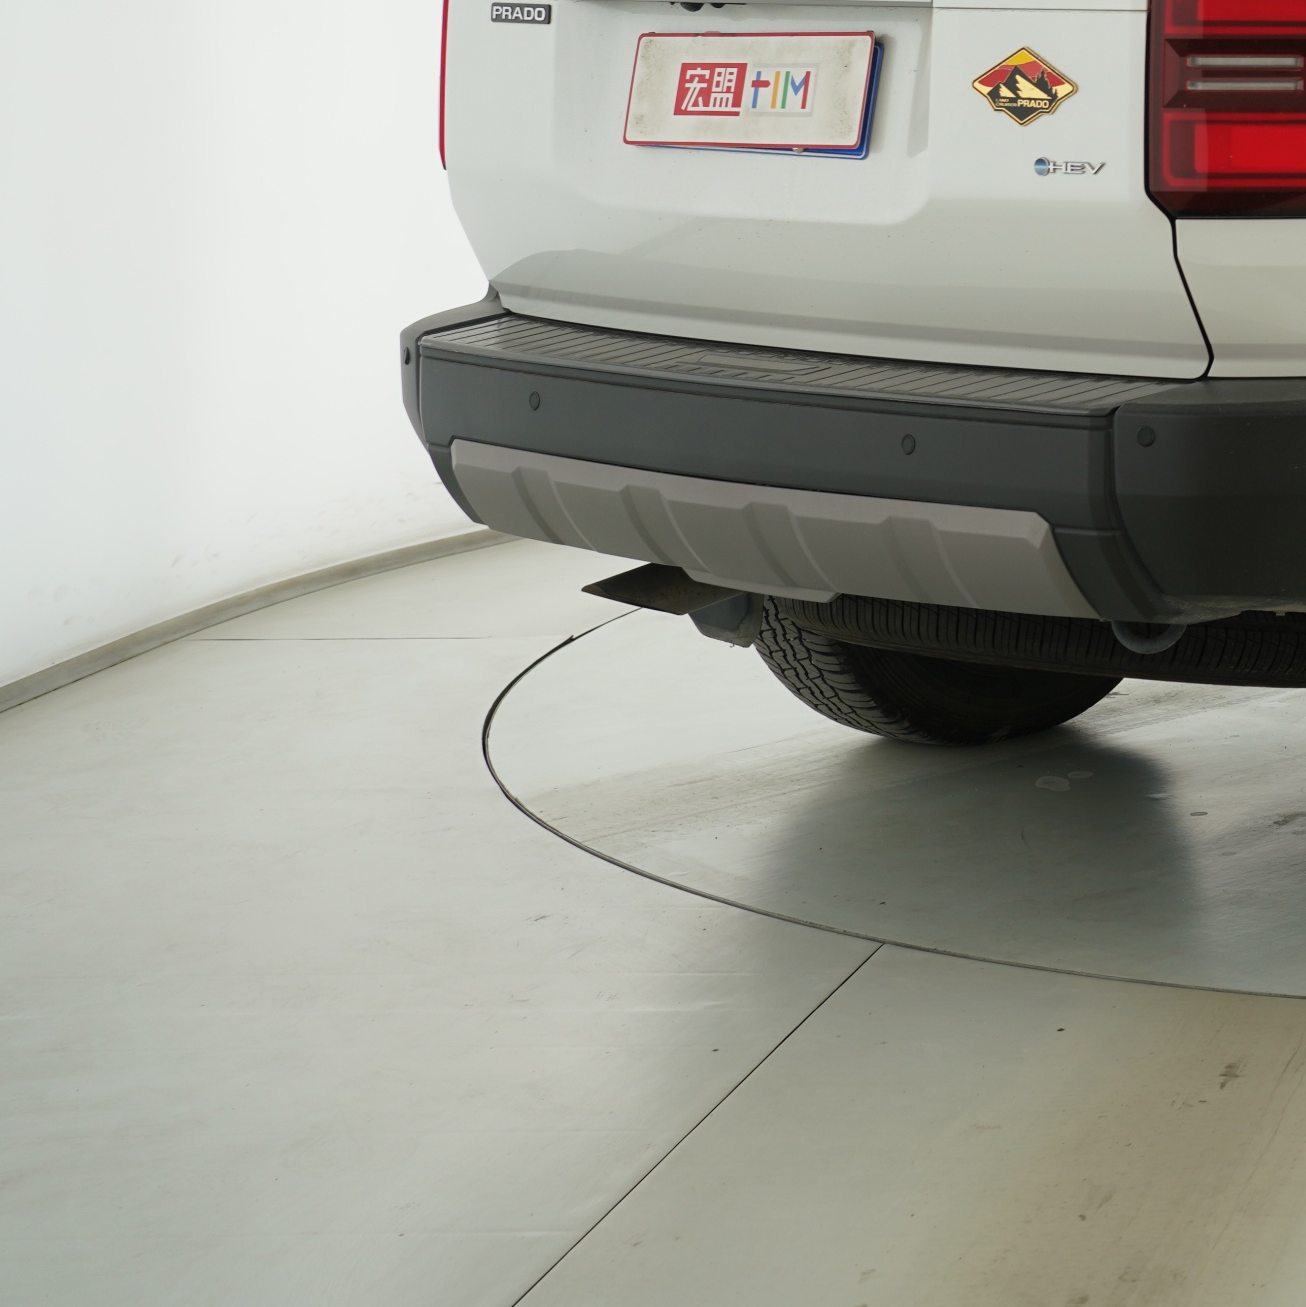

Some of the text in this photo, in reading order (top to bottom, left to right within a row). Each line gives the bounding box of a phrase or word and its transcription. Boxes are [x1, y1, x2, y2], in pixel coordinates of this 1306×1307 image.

[492, 5, 546, 22] PRADO
[680, 67, 742, 112] 宏盟
[1017, 99, 1050, 109] PRADO
[1048, 161, 1106, 174] HEV
